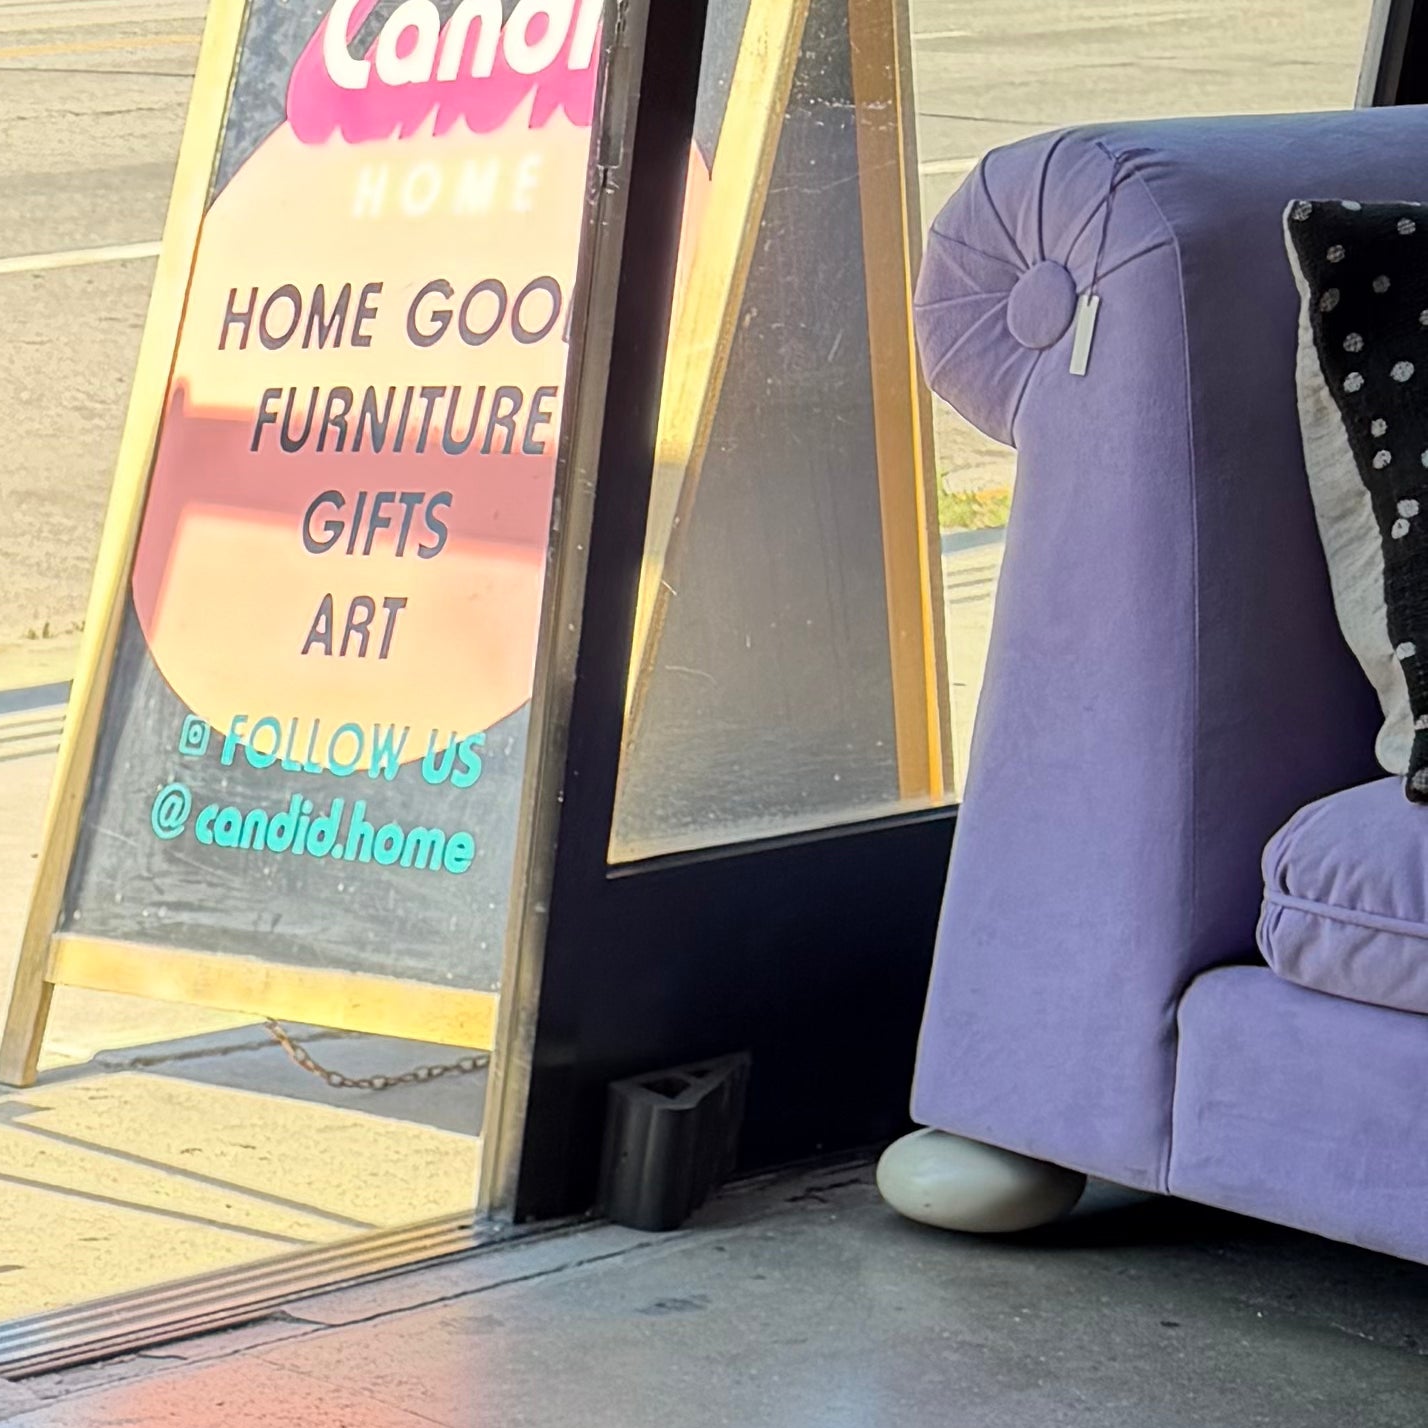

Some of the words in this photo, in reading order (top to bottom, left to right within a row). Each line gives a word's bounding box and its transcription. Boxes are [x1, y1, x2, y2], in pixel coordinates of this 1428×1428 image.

[322, 0, 604, 89] Candi
[350, 152, 543, 219] HOME
[218, 282, 383, 350] HOME
[406, 276, 575, 347] GOO
[250, 384, 559, 455] FURNITURE
[302, 489, 454, 560] GIFTS
[300, 592, 408, 660] ART
[220, 713, 411, 782] FOLLOW
[421, 728, 487, 789] US
